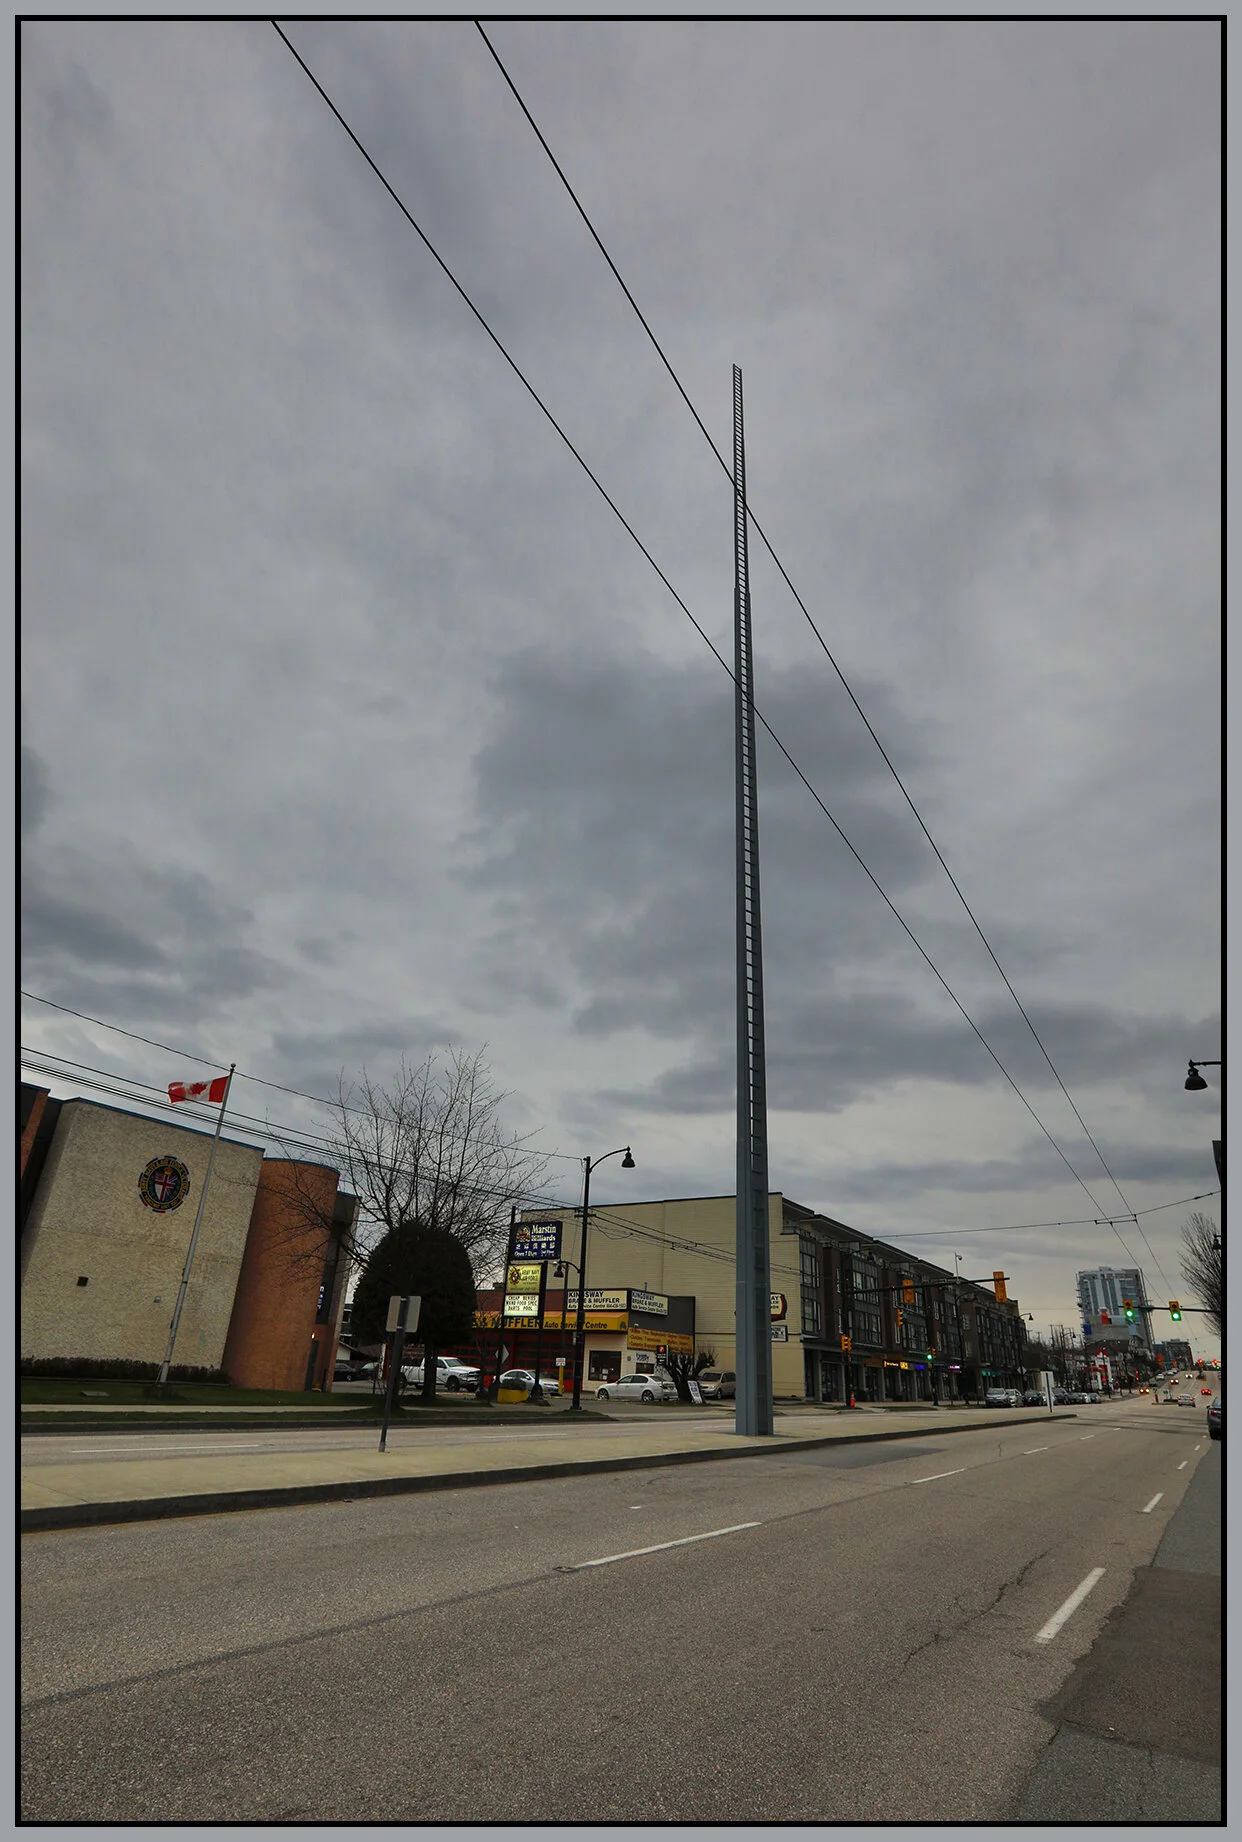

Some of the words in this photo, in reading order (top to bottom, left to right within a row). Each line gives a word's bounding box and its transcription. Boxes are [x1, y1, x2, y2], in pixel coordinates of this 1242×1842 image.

[532, 1224, 556, 1234] Marstin
[531, 1234, 556, 1242] Billiards
[632, 1292, 655, 1301] KINGSWAY
[648, 1301, 664, 1309] MUFFLER
[544, 1321, 559, 1329] Auto
[585, 1321, 608, 1329] Centre
